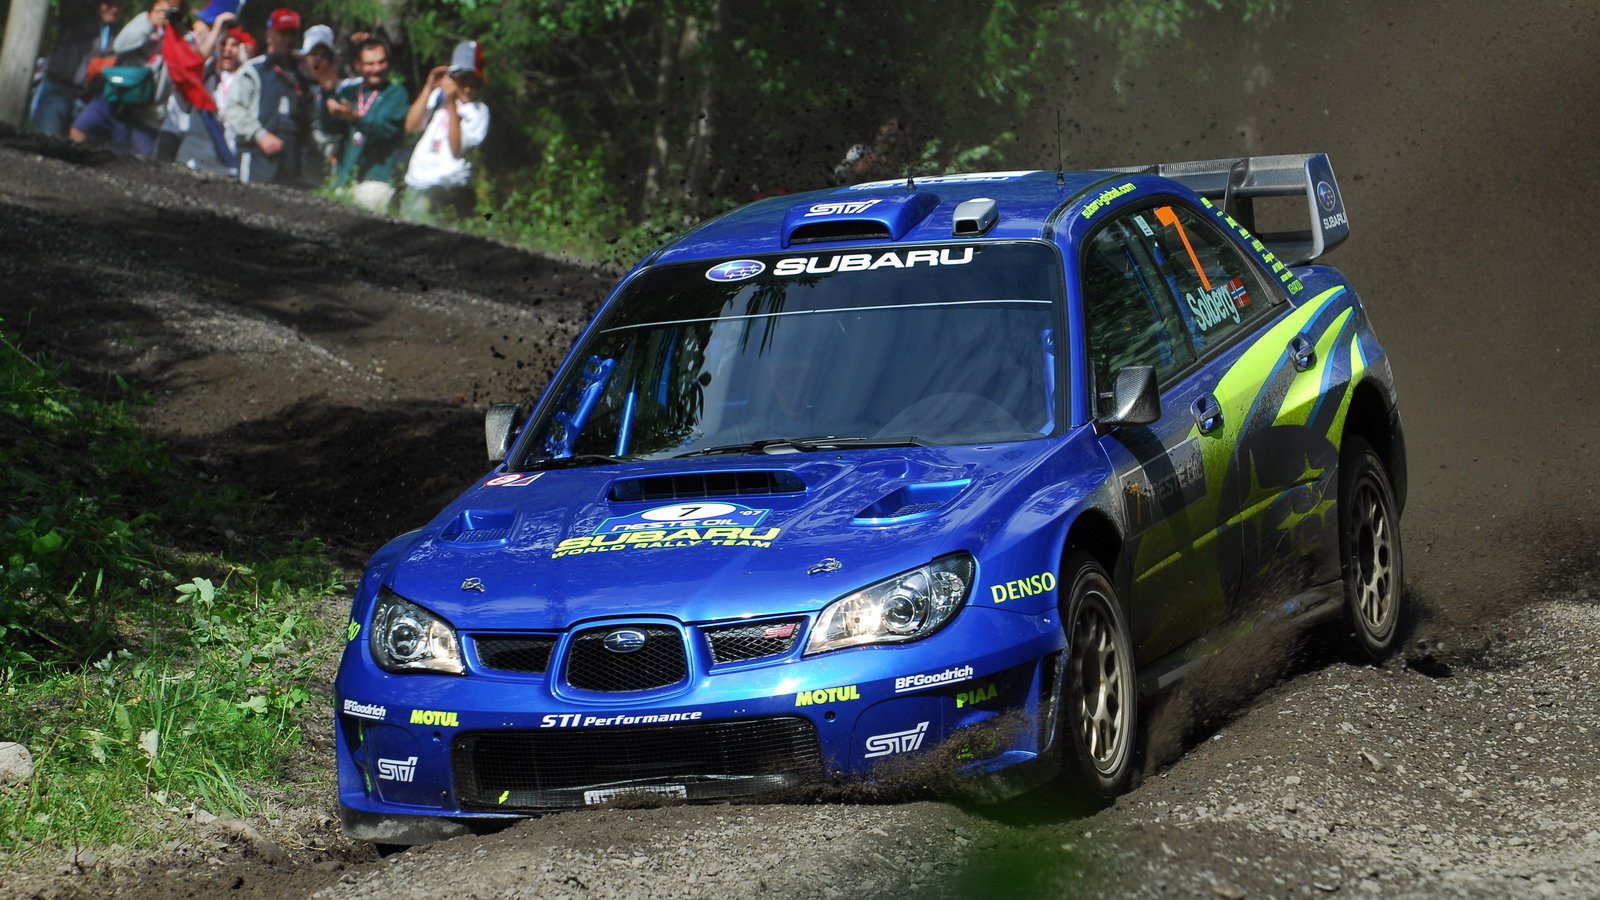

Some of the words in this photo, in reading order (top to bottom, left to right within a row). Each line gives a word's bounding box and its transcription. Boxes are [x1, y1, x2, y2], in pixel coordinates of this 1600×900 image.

[1154, 205, 1212, 291] 7
[773, 247, 974, 276] SUBARU
[1186, 284, 1241, 331] Solberg
[678, 506, 702, 518] 7
[611, 520, 700, 532] NESTE
[701, 518, 739, 527] OIL
[552, 544, 626, 559] WORLD
[633, 540, 702, 549] RALLY
[710, 539, 772, 549] TEAM
[554, 527, 781, 553] SUBARU
[990, 571, 1056, 604] DENSO
[895, 664, 974, 690] BFGoodrich
[344, 699, 386, 717] BFGoodrich
[795, 685, 861, 707] MOTUL
[956, 683, 998, 709] PIAA
[409, 709, 460, 727] MOTUL
[540, 713, 581, 728] STI
[584, 711, 703, 727] Performance
